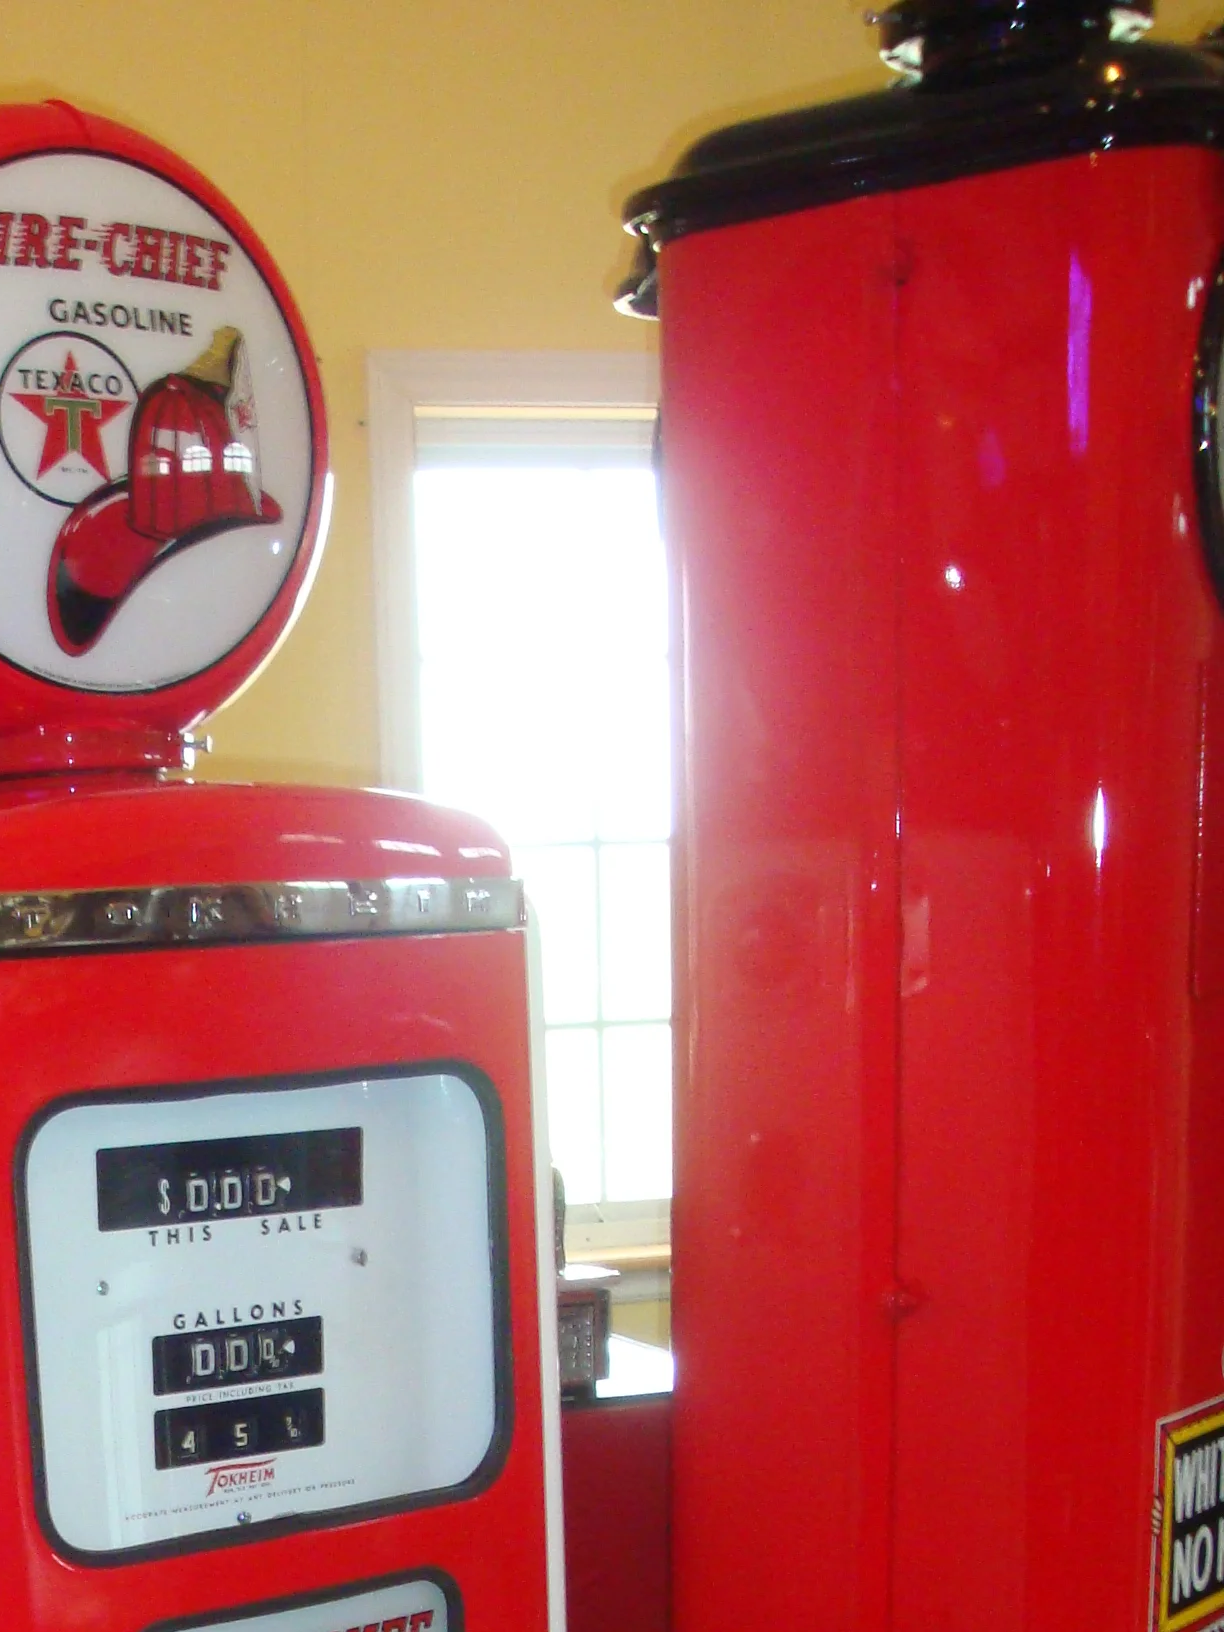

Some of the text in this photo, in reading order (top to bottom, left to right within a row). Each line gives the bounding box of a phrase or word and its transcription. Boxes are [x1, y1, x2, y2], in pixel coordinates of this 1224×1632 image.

[49, 298, 194, 337] GASOLINE
[17, 368, 124, 396] TEXACO
[148, 1213, 323, 1247] THIS SALE
[173, 1299, 304, 1331] GALLONS
[204, 1458, 277, 1497] TOKHEIM
[1174, 1438, 1224, 1523] WHIT
[1173, 1524, 1214, 1603] NO
